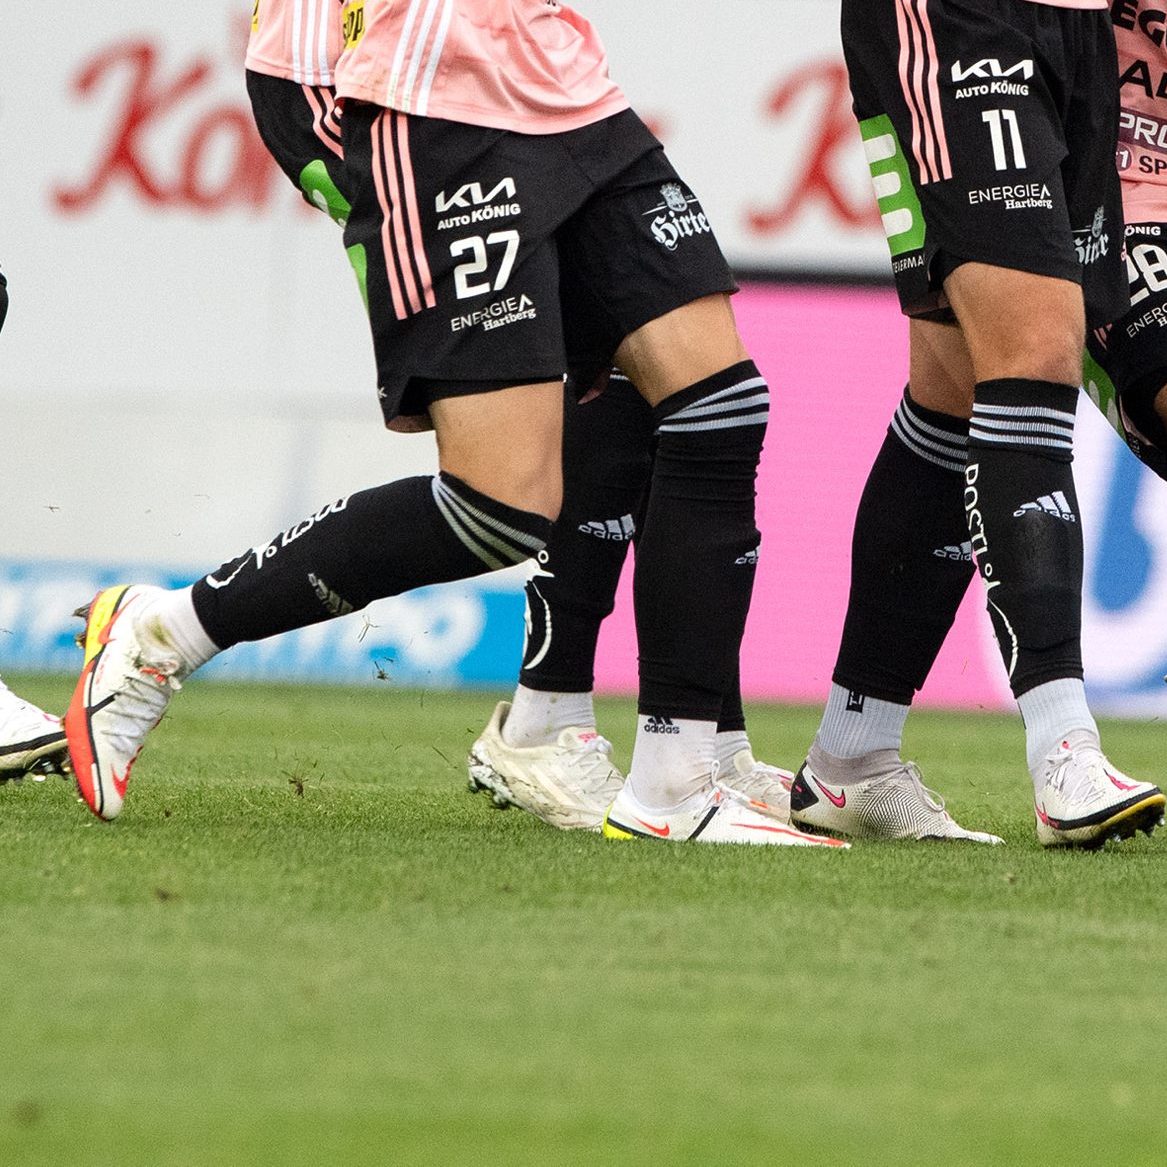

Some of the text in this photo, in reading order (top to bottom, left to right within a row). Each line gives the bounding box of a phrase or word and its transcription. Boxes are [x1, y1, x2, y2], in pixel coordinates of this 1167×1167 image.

[955, 80, 1029, 100] AUTO KÖNIG
[981, 108, 1027, 171] 11
[1004, 198, 1053, 210] Hartberg
[437, 203, 522, 231] AUTO KÖNIG
[650, 209, 711, 251] Hirte
[1124, 225, 1161, 237] ÖNIG
[449, 229, 521, 300] 27
[482, 307, 537, 332] Hartberg
[644, 723, 680, 735] adidas
